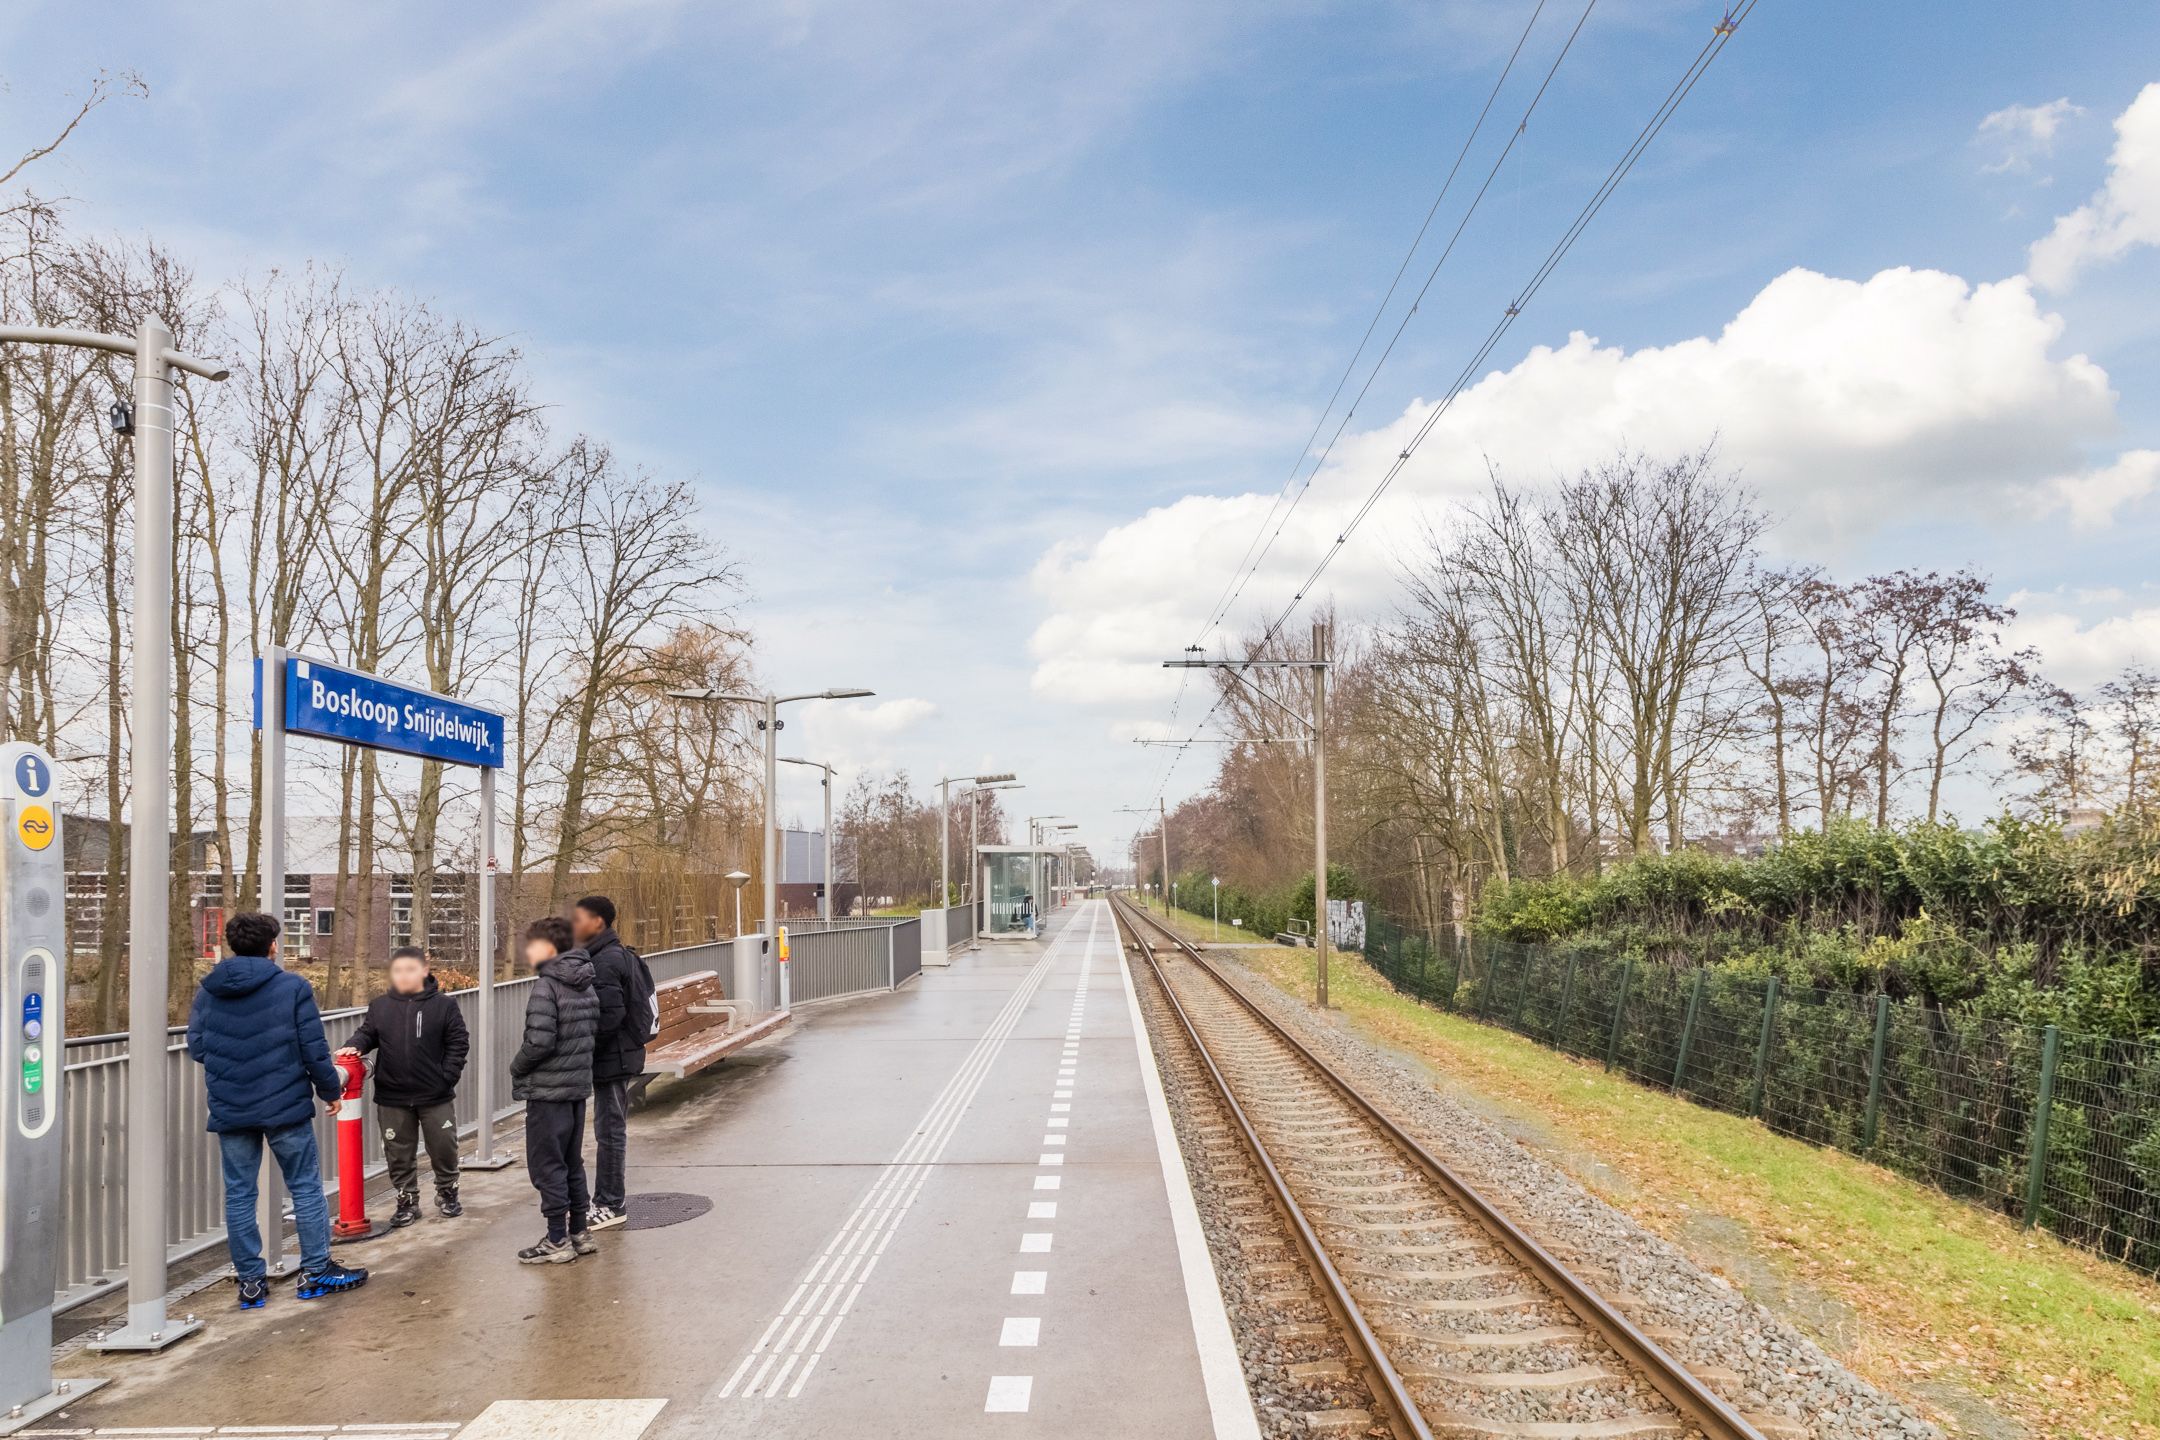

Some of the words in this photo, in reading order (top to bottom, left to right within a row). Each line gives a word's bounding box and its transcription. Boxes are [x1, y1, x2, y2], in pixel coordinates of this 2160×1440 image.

[312, 680, 398, 732] Boskoop
[404, 704, 490, 751] Snijdelwijk
[27, 758, 40, 791] i
